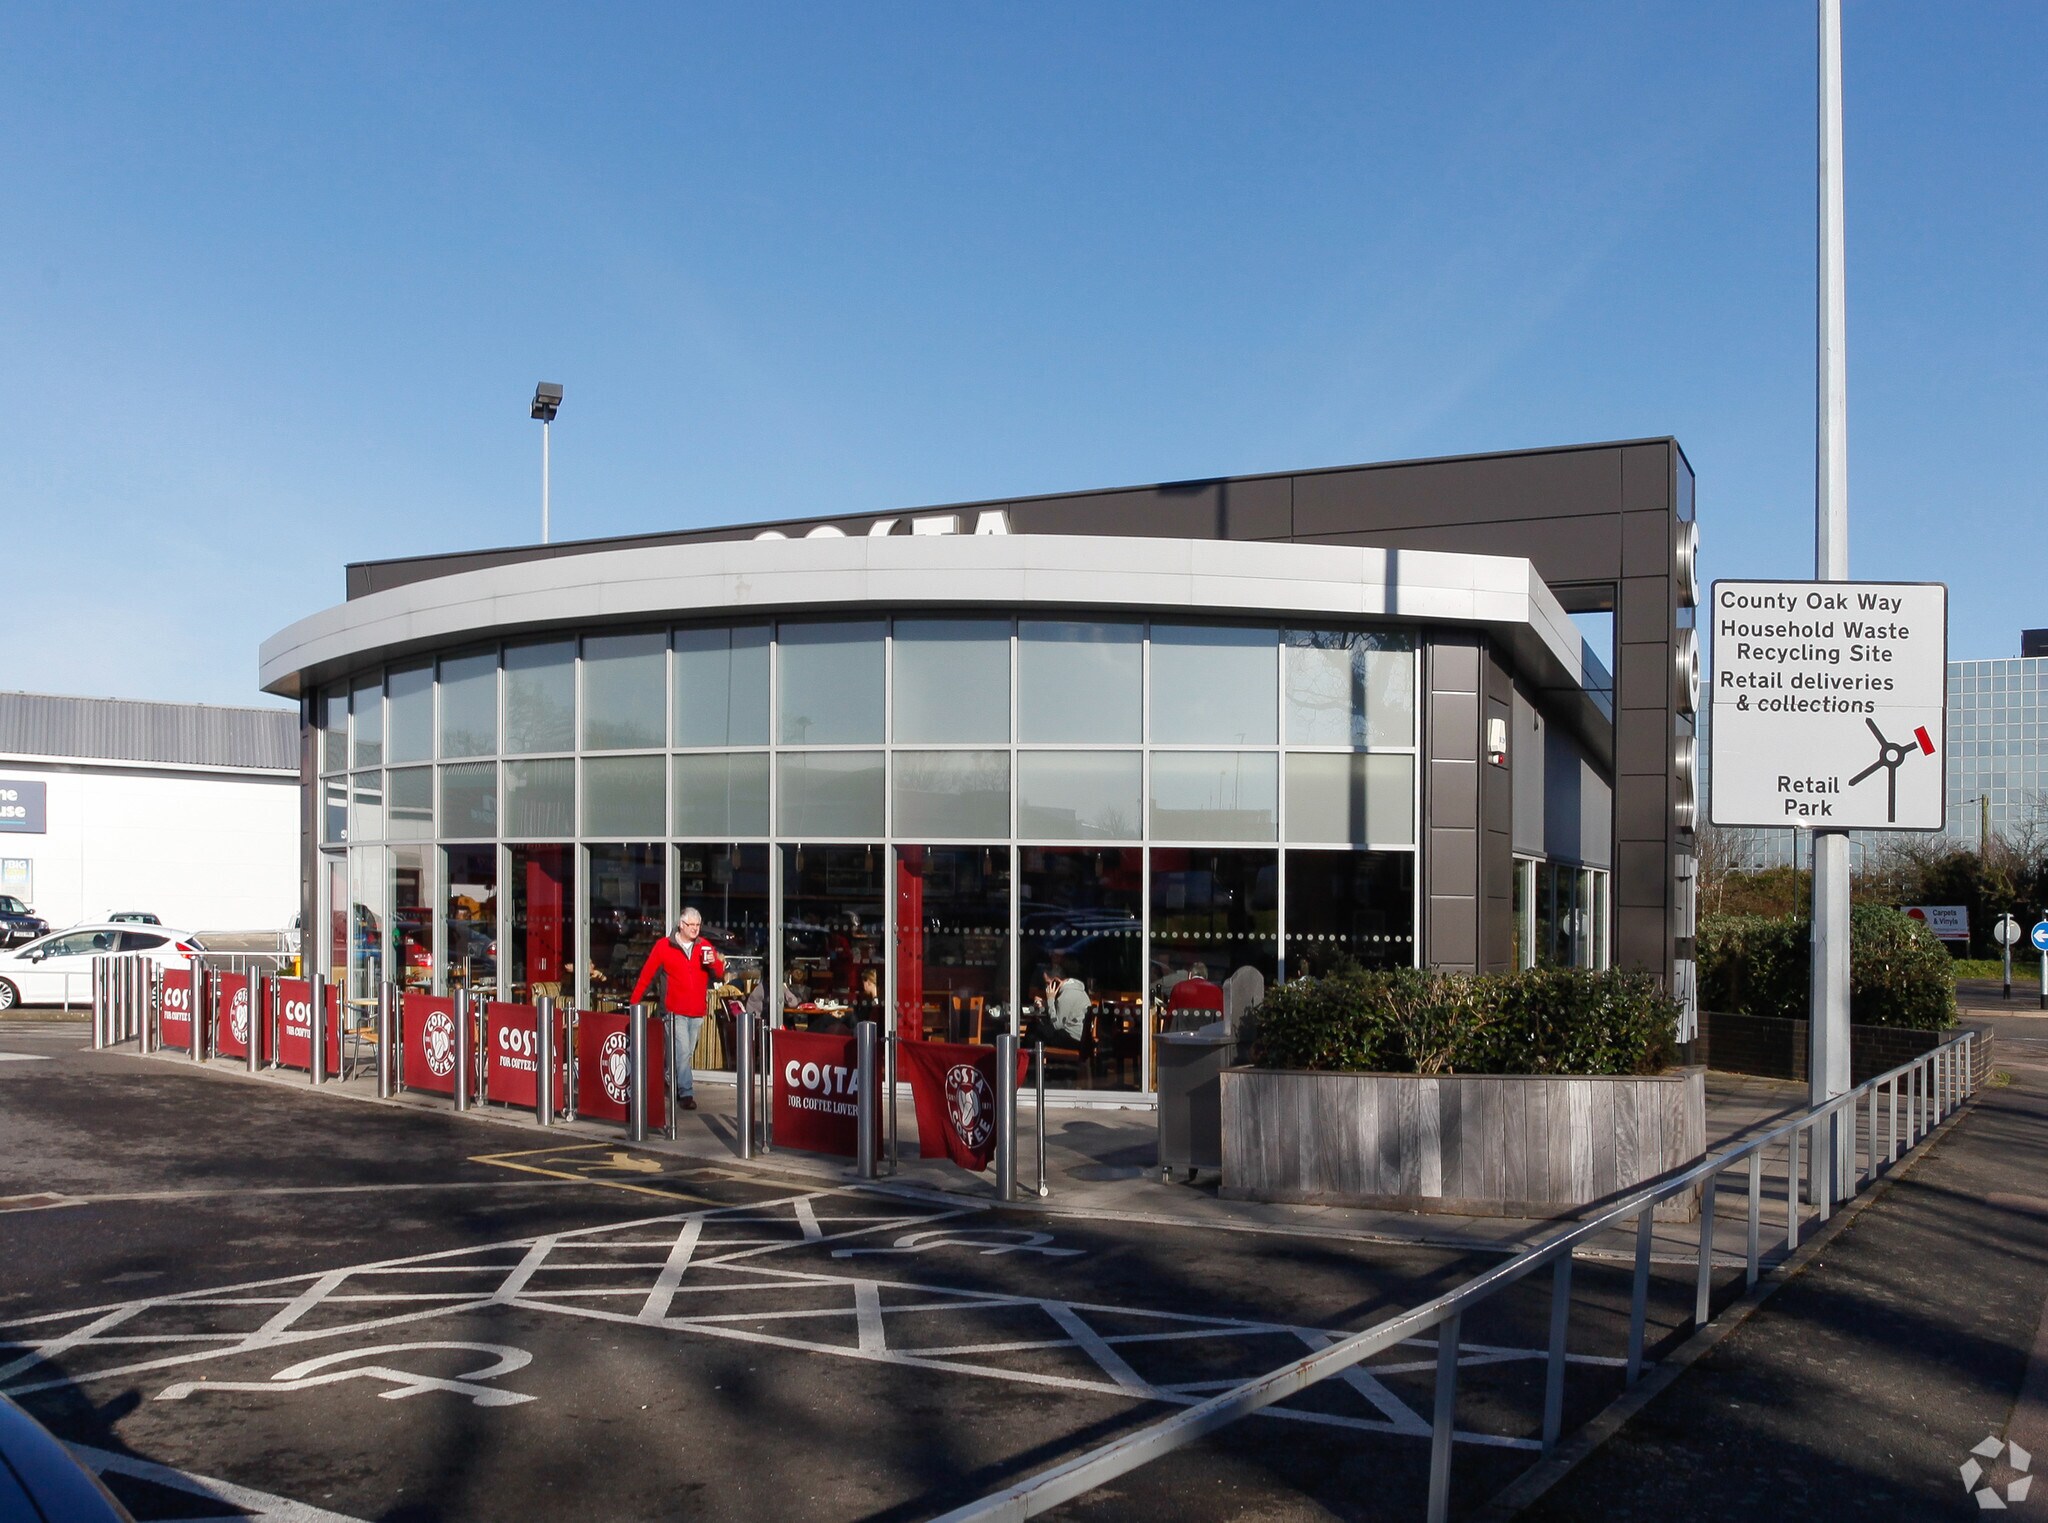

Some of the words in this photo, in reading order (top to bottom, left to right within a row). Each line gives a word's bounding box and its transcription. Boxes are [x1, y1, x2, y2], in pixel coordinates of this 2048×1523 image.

[1720, 591, 1798, 613] County
[1806, 592, 1848, 610] Oak
[1857, 593, 1903, 614] Way
[1721, 620, 1834, 638] Household
[1843, 621, 1910, 639] Waste
[1737, 643, 1840, 664] Recycling
[1849, 644, 1893, 662] Site
[1720, 671, 1782, 689] Retail
[1790, 672, 1894, 691] deliveries
[1736, 694, 1750, 711] &
[1757, 695, 1875, 713] collections
[1777, 776, 1840, 794] Retail
[1784, 799, 1833, 816] Park
[1932, 909, 1957, 917] Carpets
[1939, 918, 1958, 926] Vinyls
[164, 987, 192, 1011] COS
[285, 1000, 311, 1027] COS
[427, 1014, 451, 1035] COSTA
[427, 1048, 456, 1074] COFFEE
[948, 1067, 984, 1094] COSTA
[802, 1097, 833, 1114] COFFEE
[833, 1101, 859, 1117] LOVER
[952, 1110, 991, 1146] COFFEE
